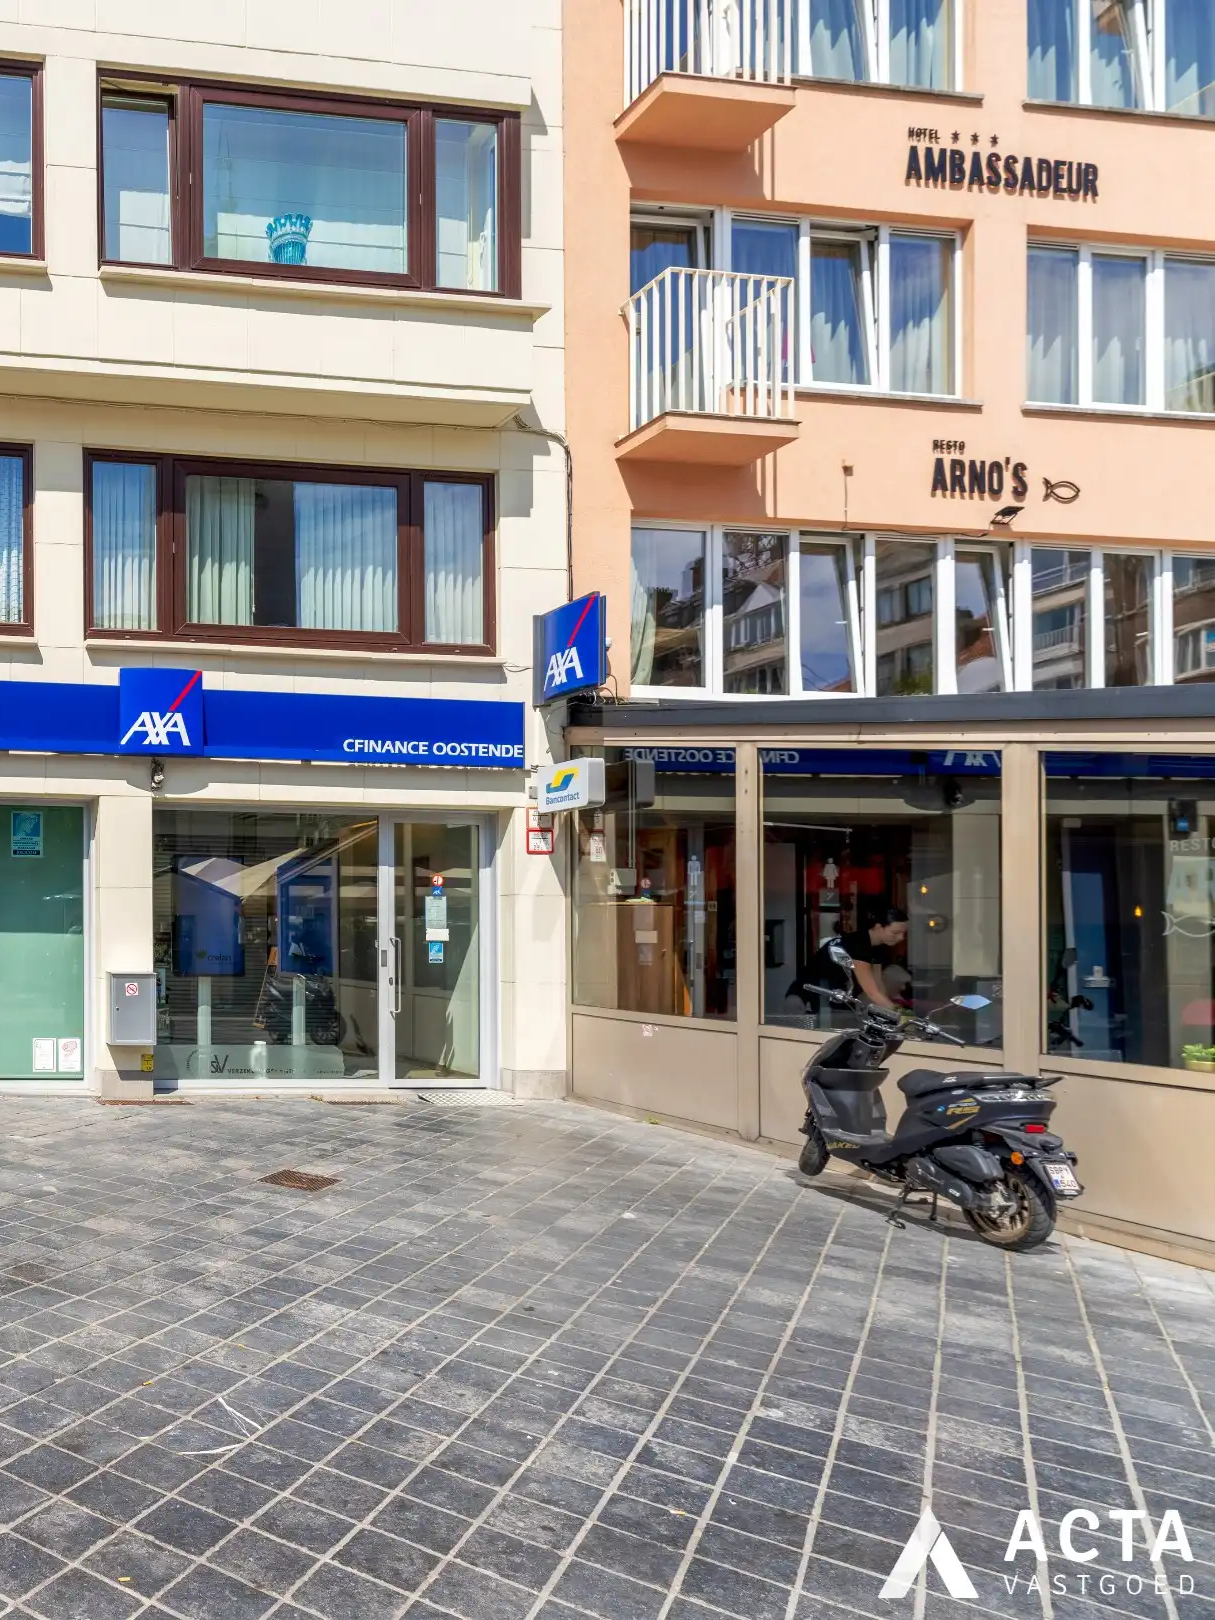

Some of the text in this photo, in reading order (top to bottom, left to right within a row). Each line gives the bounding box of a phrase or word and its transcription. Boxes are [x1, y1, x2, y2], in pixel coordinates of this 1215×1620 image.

[908, 127, 940, 141] HOTEL
[905, 145, 1099, 197] AMBASSADEUR
[932, 440, 965, 451] RESTO
[931, 457, 1028, 497] ARNO'S
[544, 647, 584, 691] AXA
[120, 711, 192, 746] AXA
[343, 738, 524, 758] CFINANCE OOSTENDE
[545, 791, 580, 805] Bancontact
